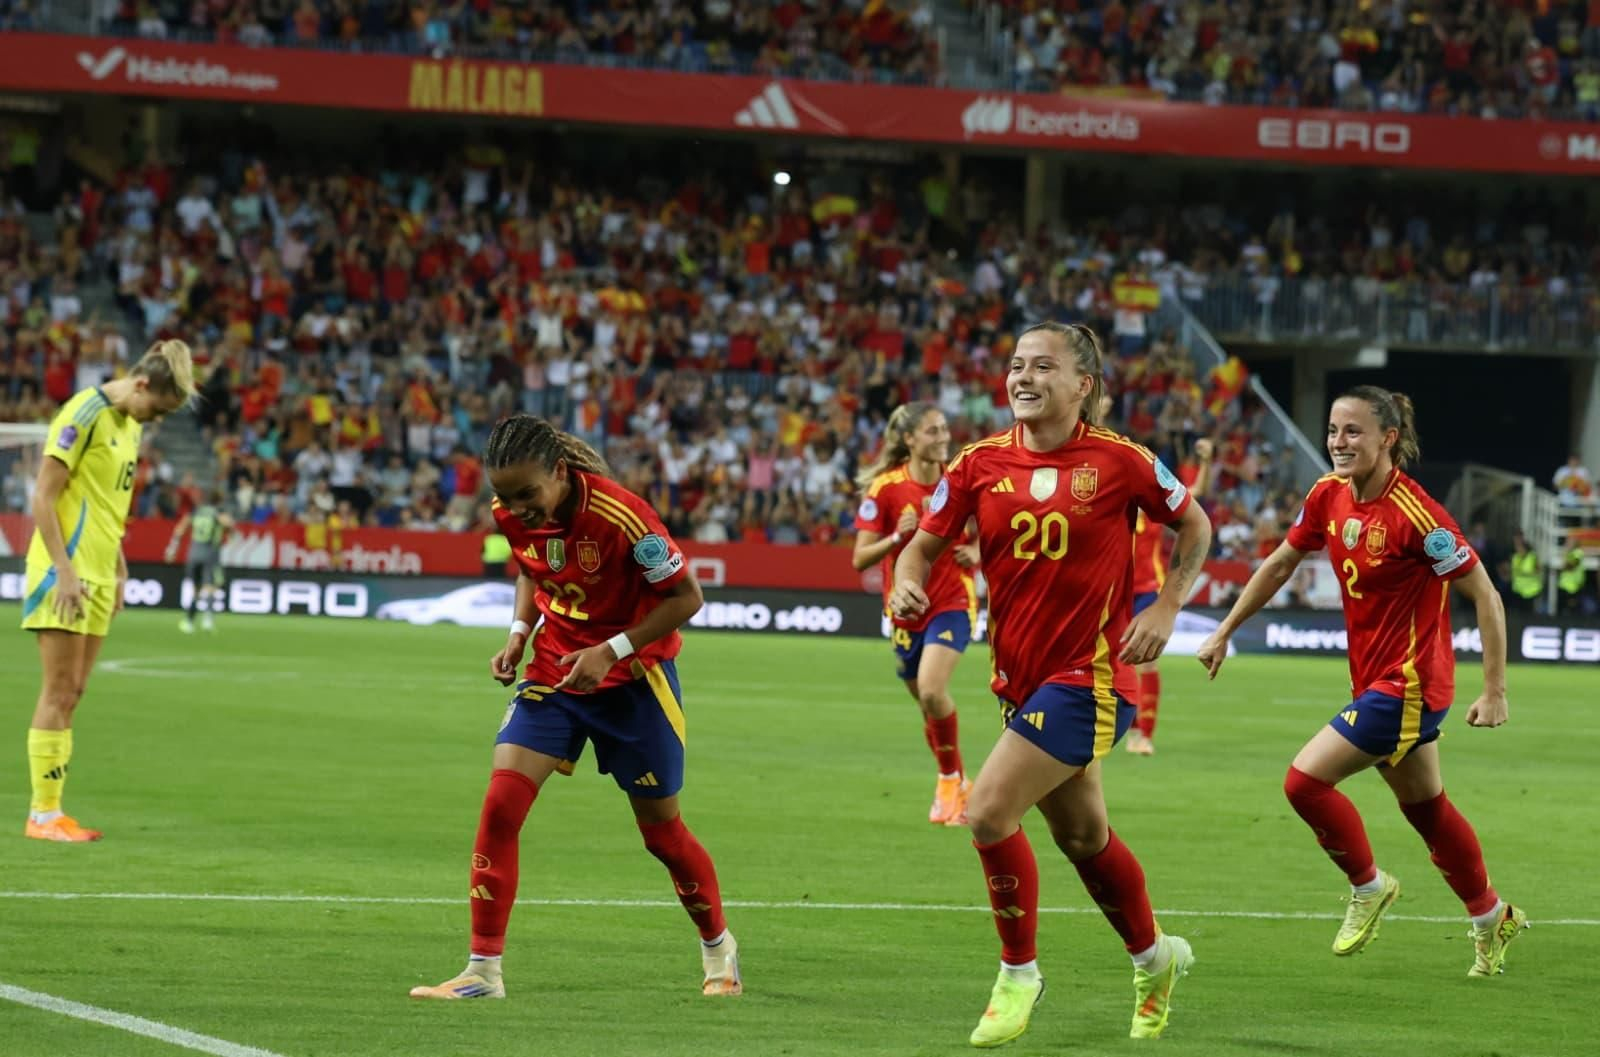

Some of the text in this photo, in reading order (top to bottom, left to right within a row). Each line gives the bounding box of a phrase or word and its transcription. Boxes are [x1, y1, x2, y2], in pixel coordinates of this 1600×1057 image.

[409, 57, 544, 117] MÁLAGA
[1015, 104, 1141, 140] Iberdrola
[1010, 510, 1069, 561] 20
[541, 579, 590, 622] 22
[1342, 558, 1364, 600] 2
